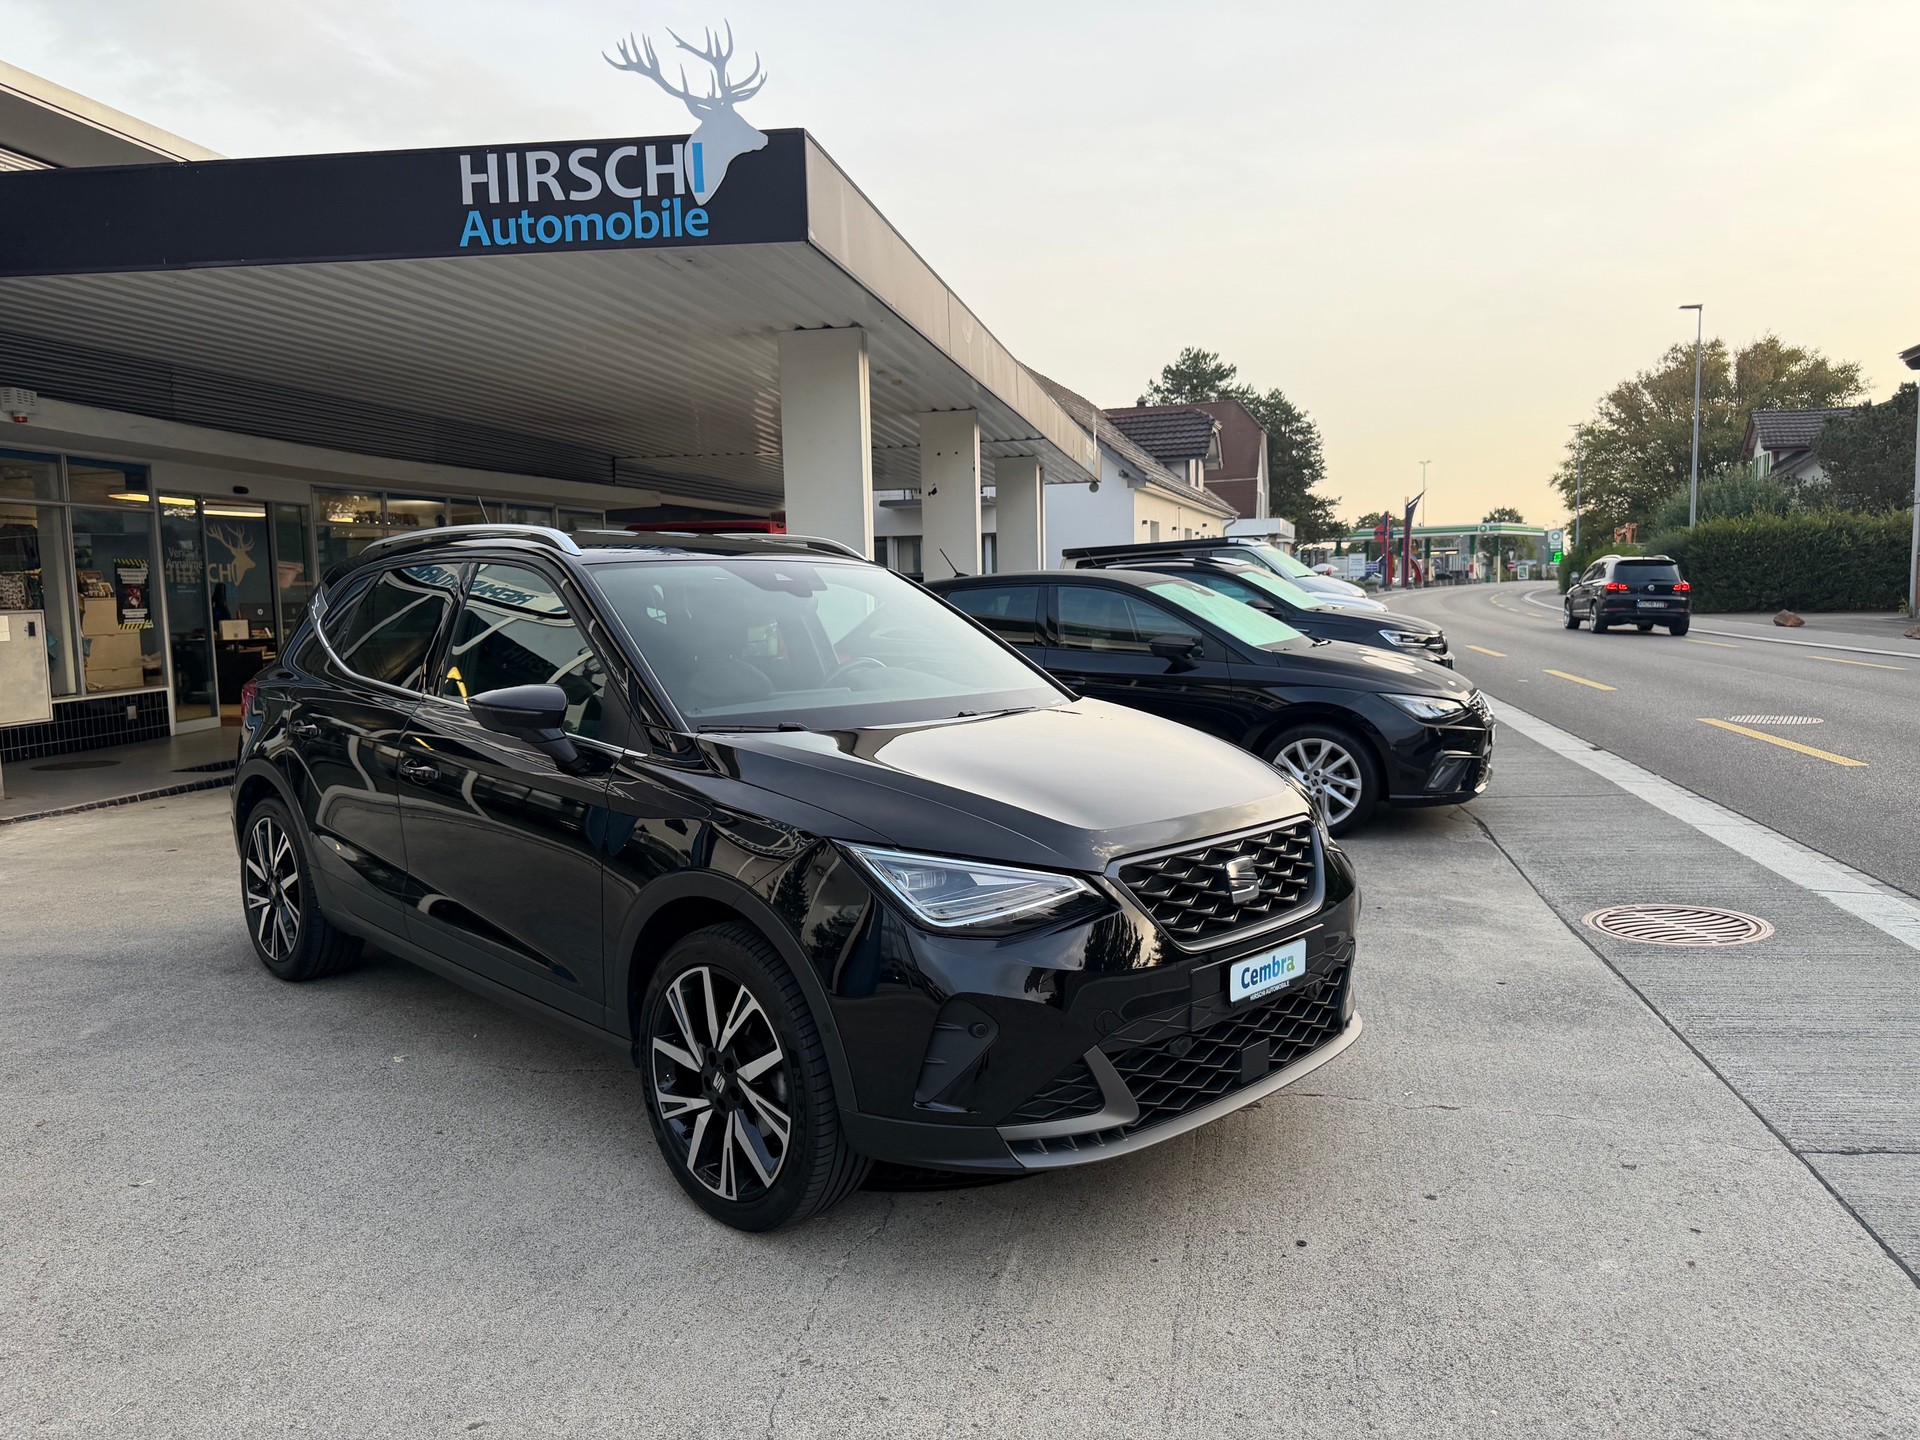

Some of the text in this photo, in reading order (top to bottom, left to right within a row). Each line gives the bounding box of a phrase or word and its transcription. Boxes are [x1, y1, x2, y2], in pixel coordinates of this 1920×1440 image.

[459, 142, 705, 205] HIRSCHI
[459, 197, 709, 247] Automobile
[1241, 955, 1295, 989] Cembra
